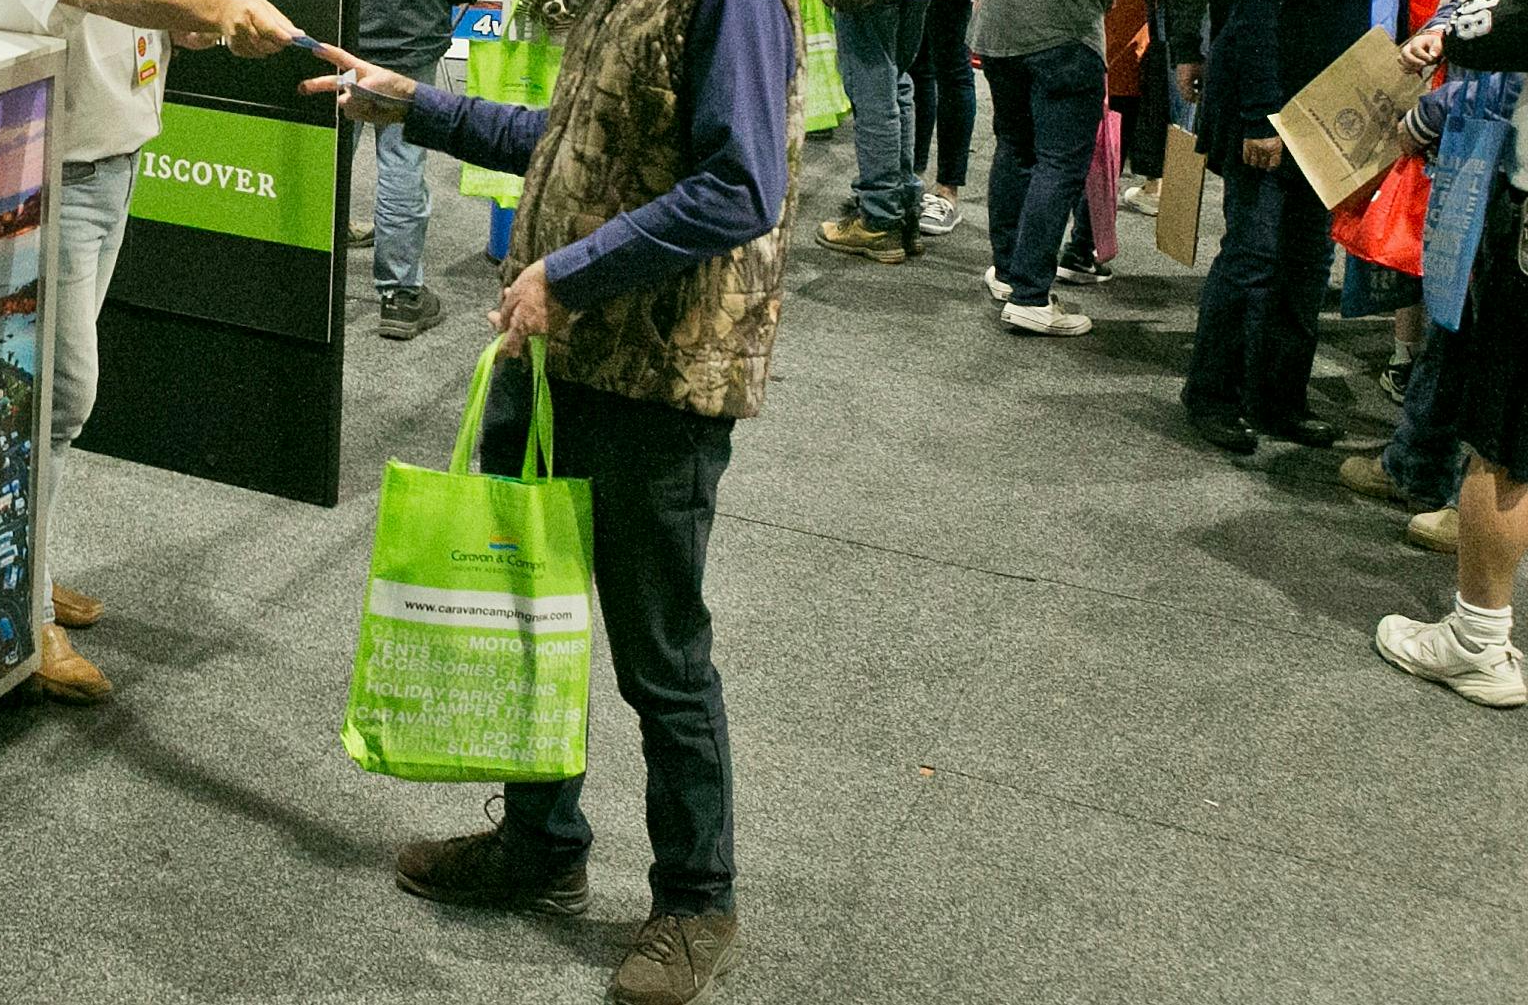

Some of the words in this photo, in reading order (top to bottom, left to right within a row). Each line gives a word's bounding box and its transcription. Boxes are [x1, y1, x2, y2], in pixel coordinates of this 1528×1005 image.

[142, 151, 277, 198] ISCOVER
[450, 549, 494, 564] Caravan
[373, 638, 430, 661] TENTS
[368, 652, 497, 677] ACCESSORIES
[365, 680, 445, 701] HOLIDAY
[448, 688, 507, 706] PARKS
[355, 706, 452, 728] CARAVANS
[423, 699, 498, 719] CAMPER
[446, 740, 538, 763] SLIDEONS
